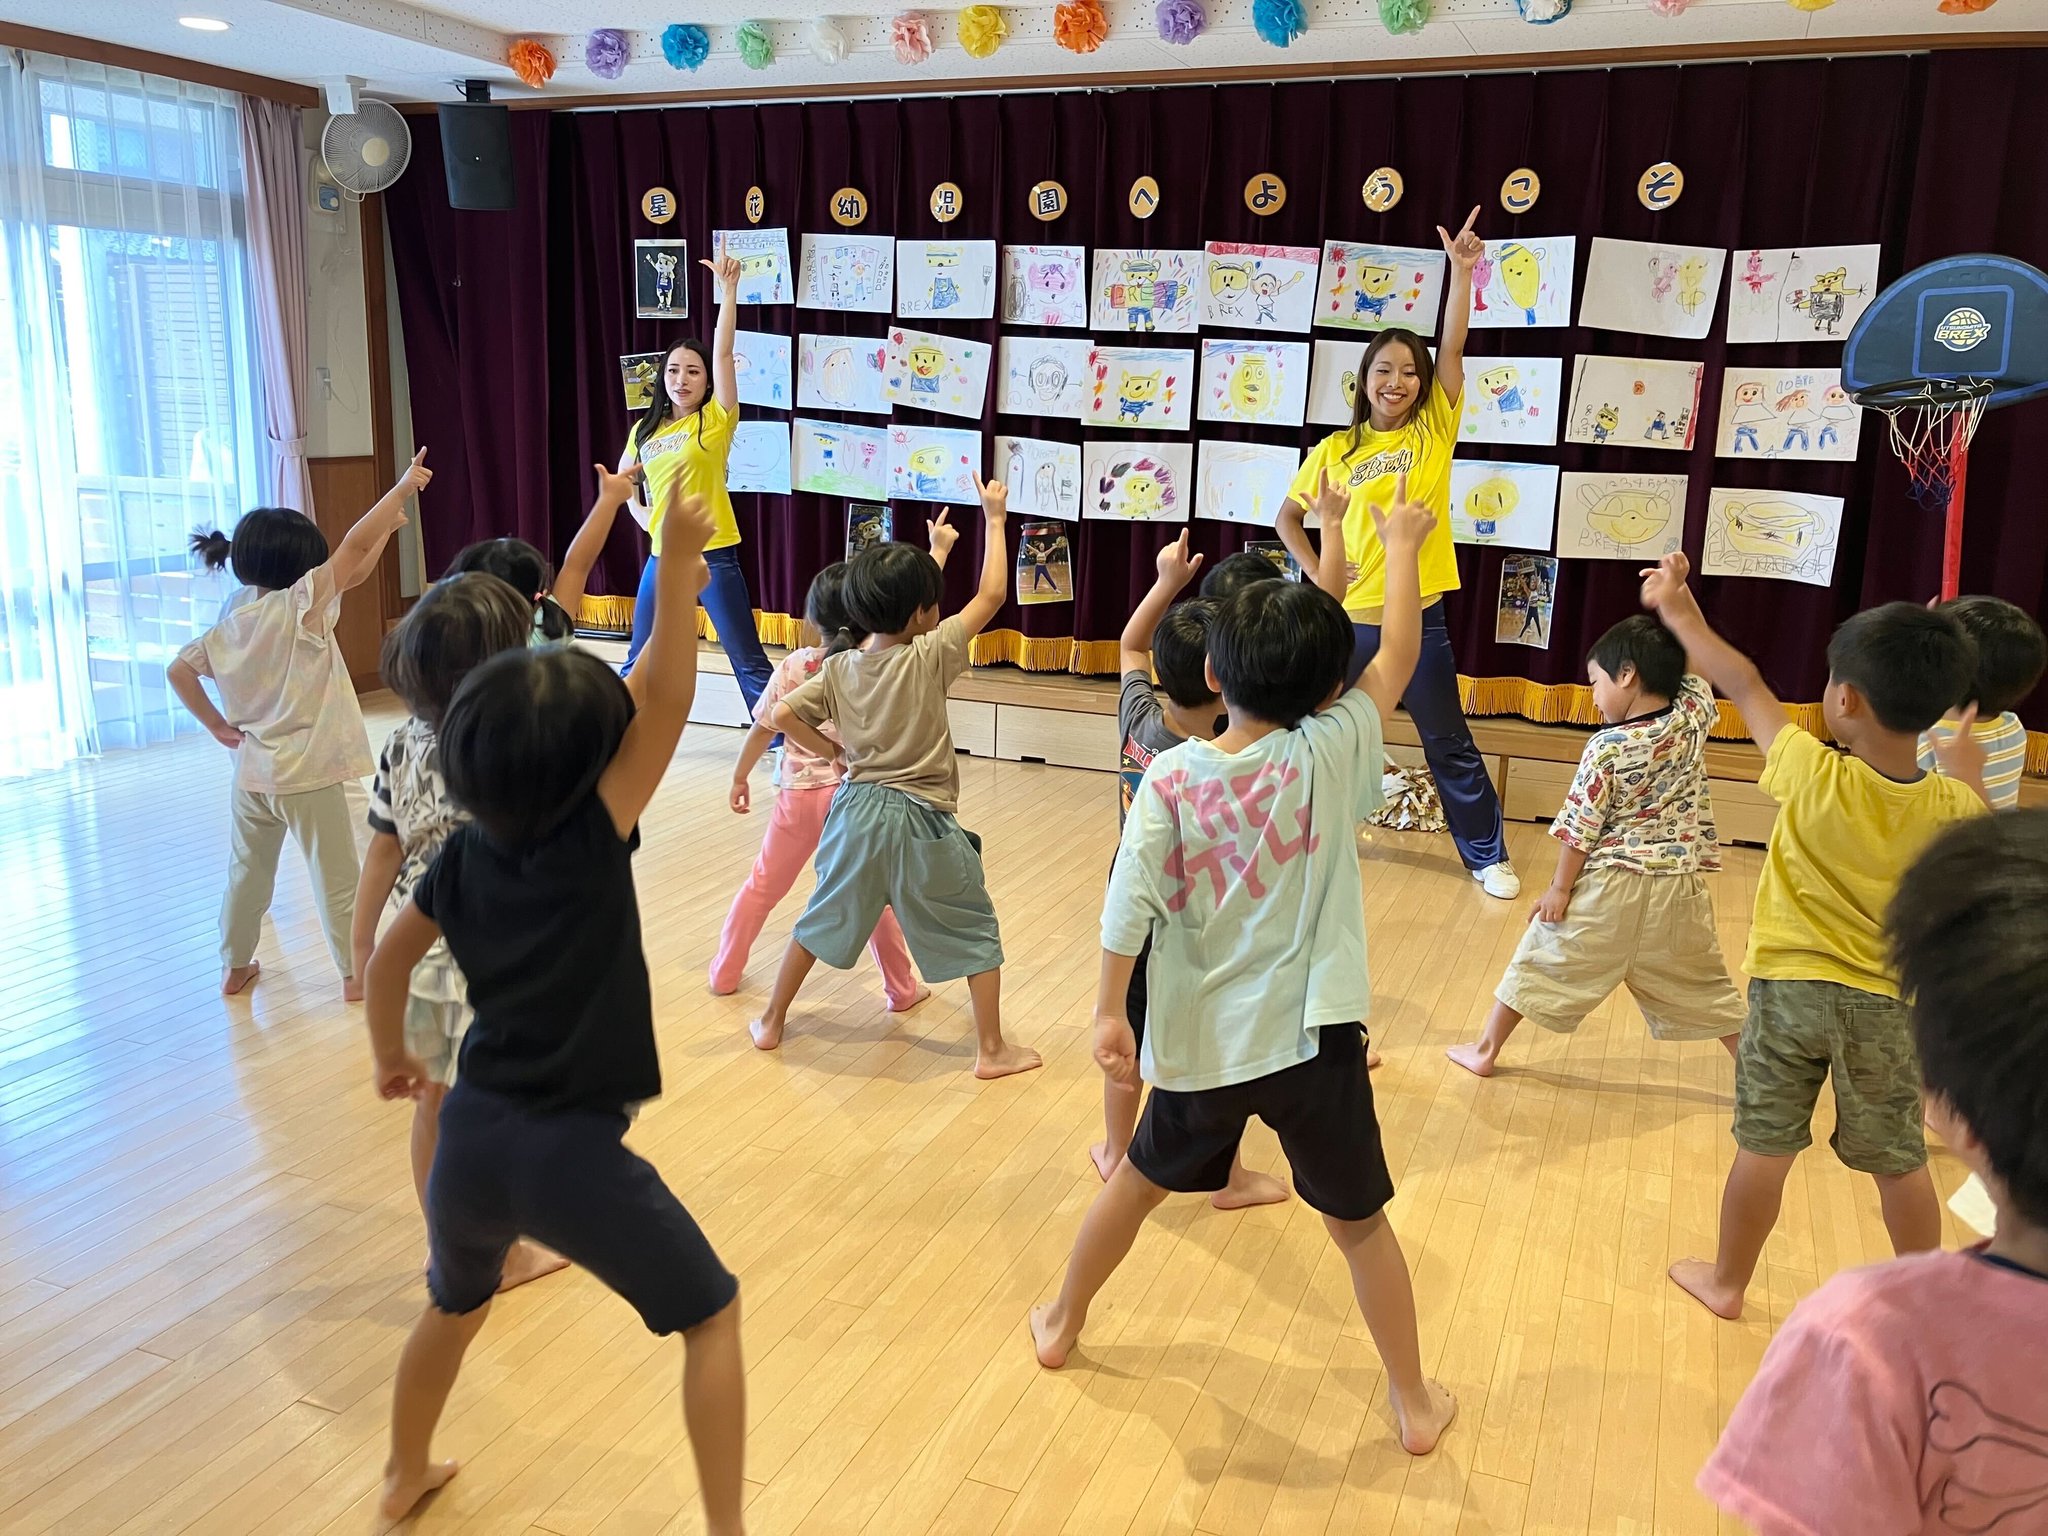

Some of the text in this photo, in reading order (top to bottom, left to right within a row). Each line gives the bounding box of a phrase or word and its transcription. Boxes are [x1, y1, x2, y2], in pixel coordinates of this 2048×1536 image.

[649, 170, 1676, 219] 星 花 幼 児 園 へ よ う こ そ
[1937, 326, 1988, 340] BREX
